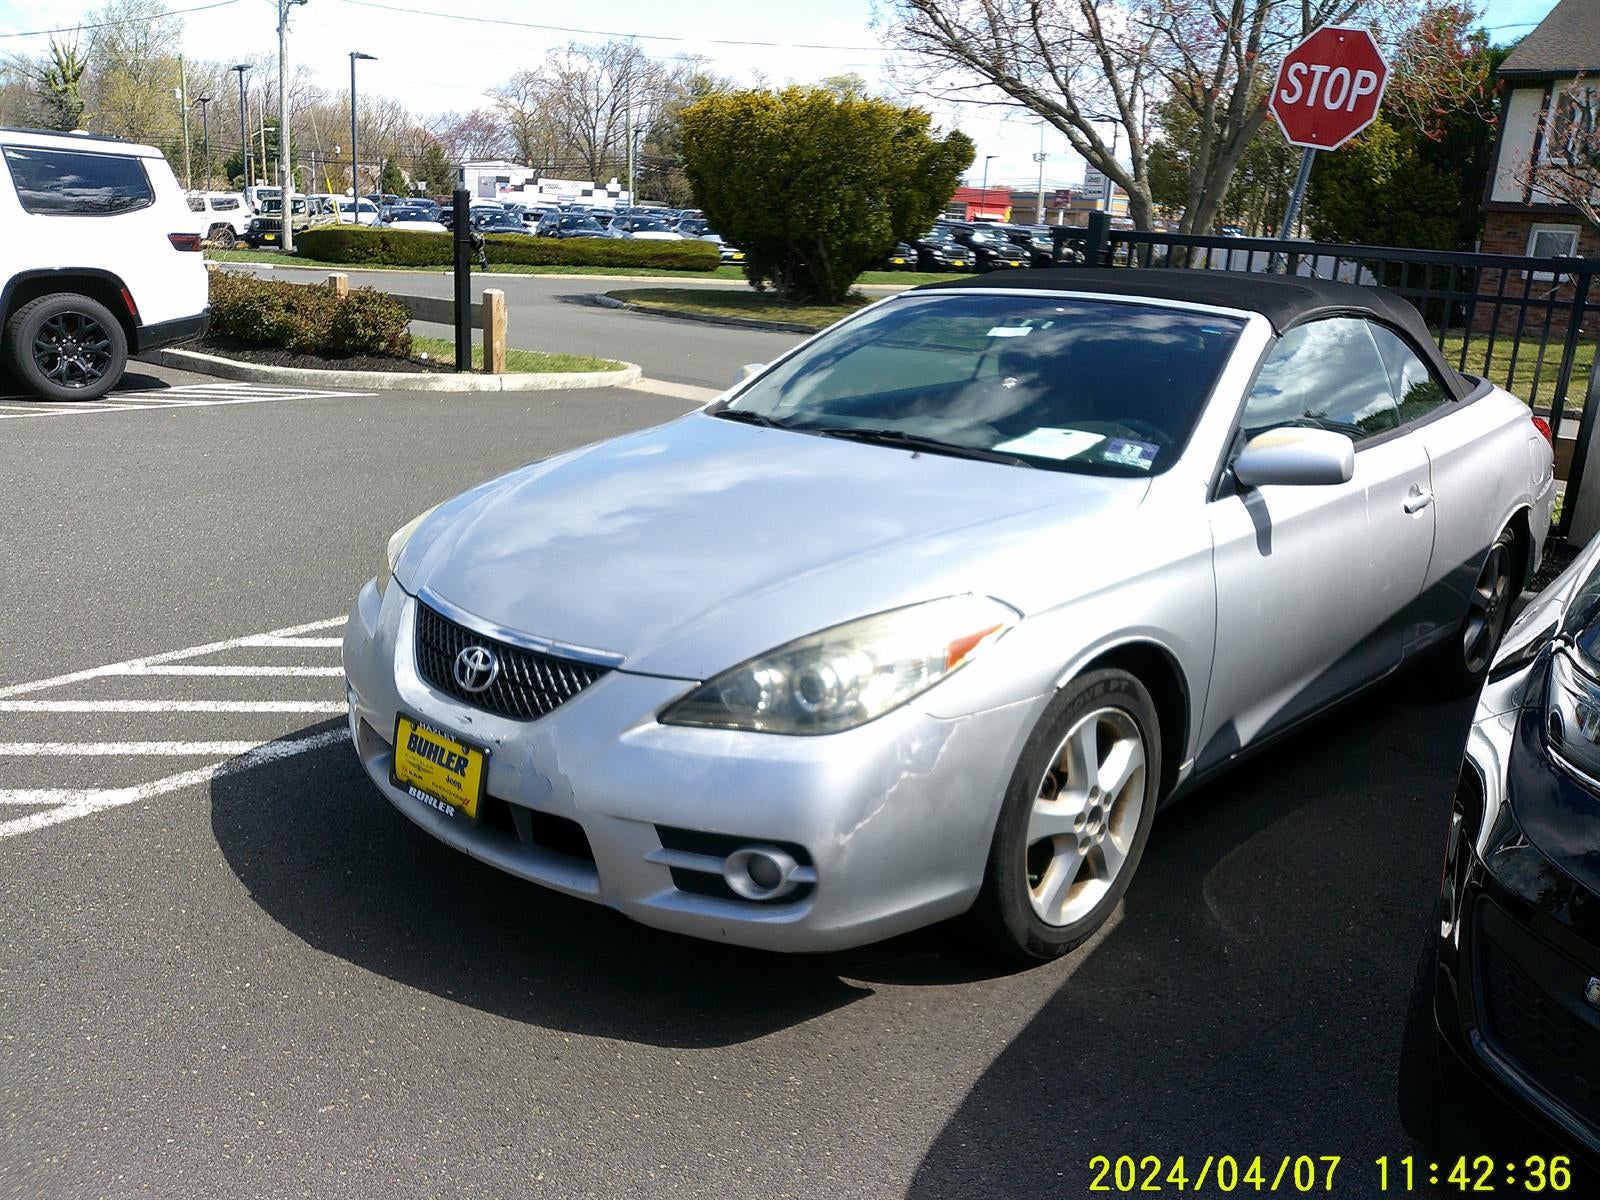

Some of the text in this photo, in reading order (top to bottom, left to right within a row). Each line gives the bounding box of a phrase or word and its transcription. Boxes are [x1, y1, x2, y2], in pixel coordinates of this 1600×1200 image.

[1280, 62, 1378, 112] STOP
[407, 733, 469, 777] BUHLER
[408, 785, 455, 818] BUHLER
